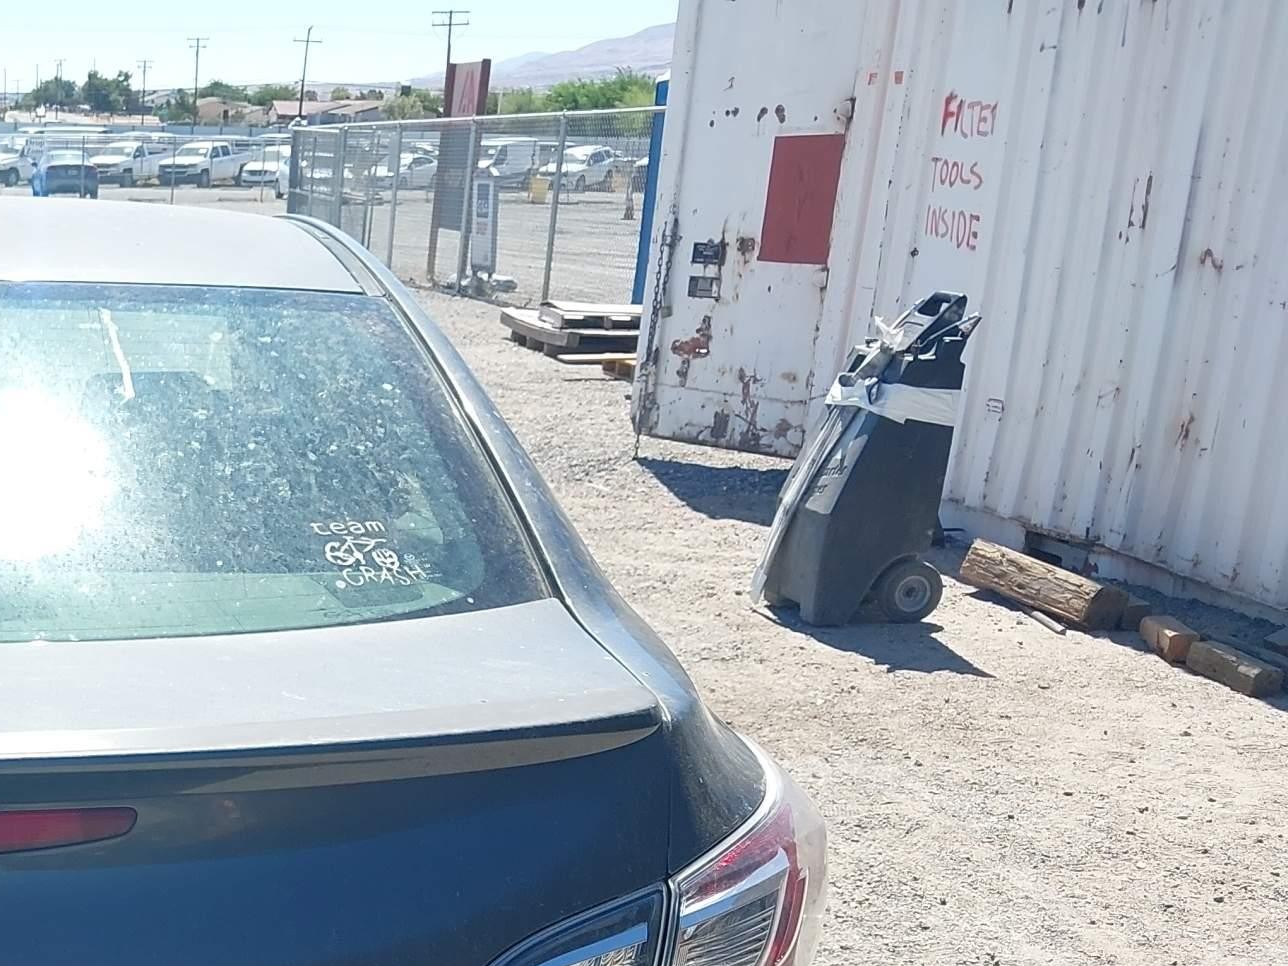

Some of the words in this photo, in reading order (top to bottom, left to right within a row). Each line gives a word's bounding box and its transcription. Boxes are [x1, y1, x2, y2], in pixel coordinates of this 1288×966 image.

[931, 156, 983, 192] TOOLS
[924, 204, 980, 251] INSIDE
[310, 520, 385, 535] team
[342, 563, 428, 586] CRASH
